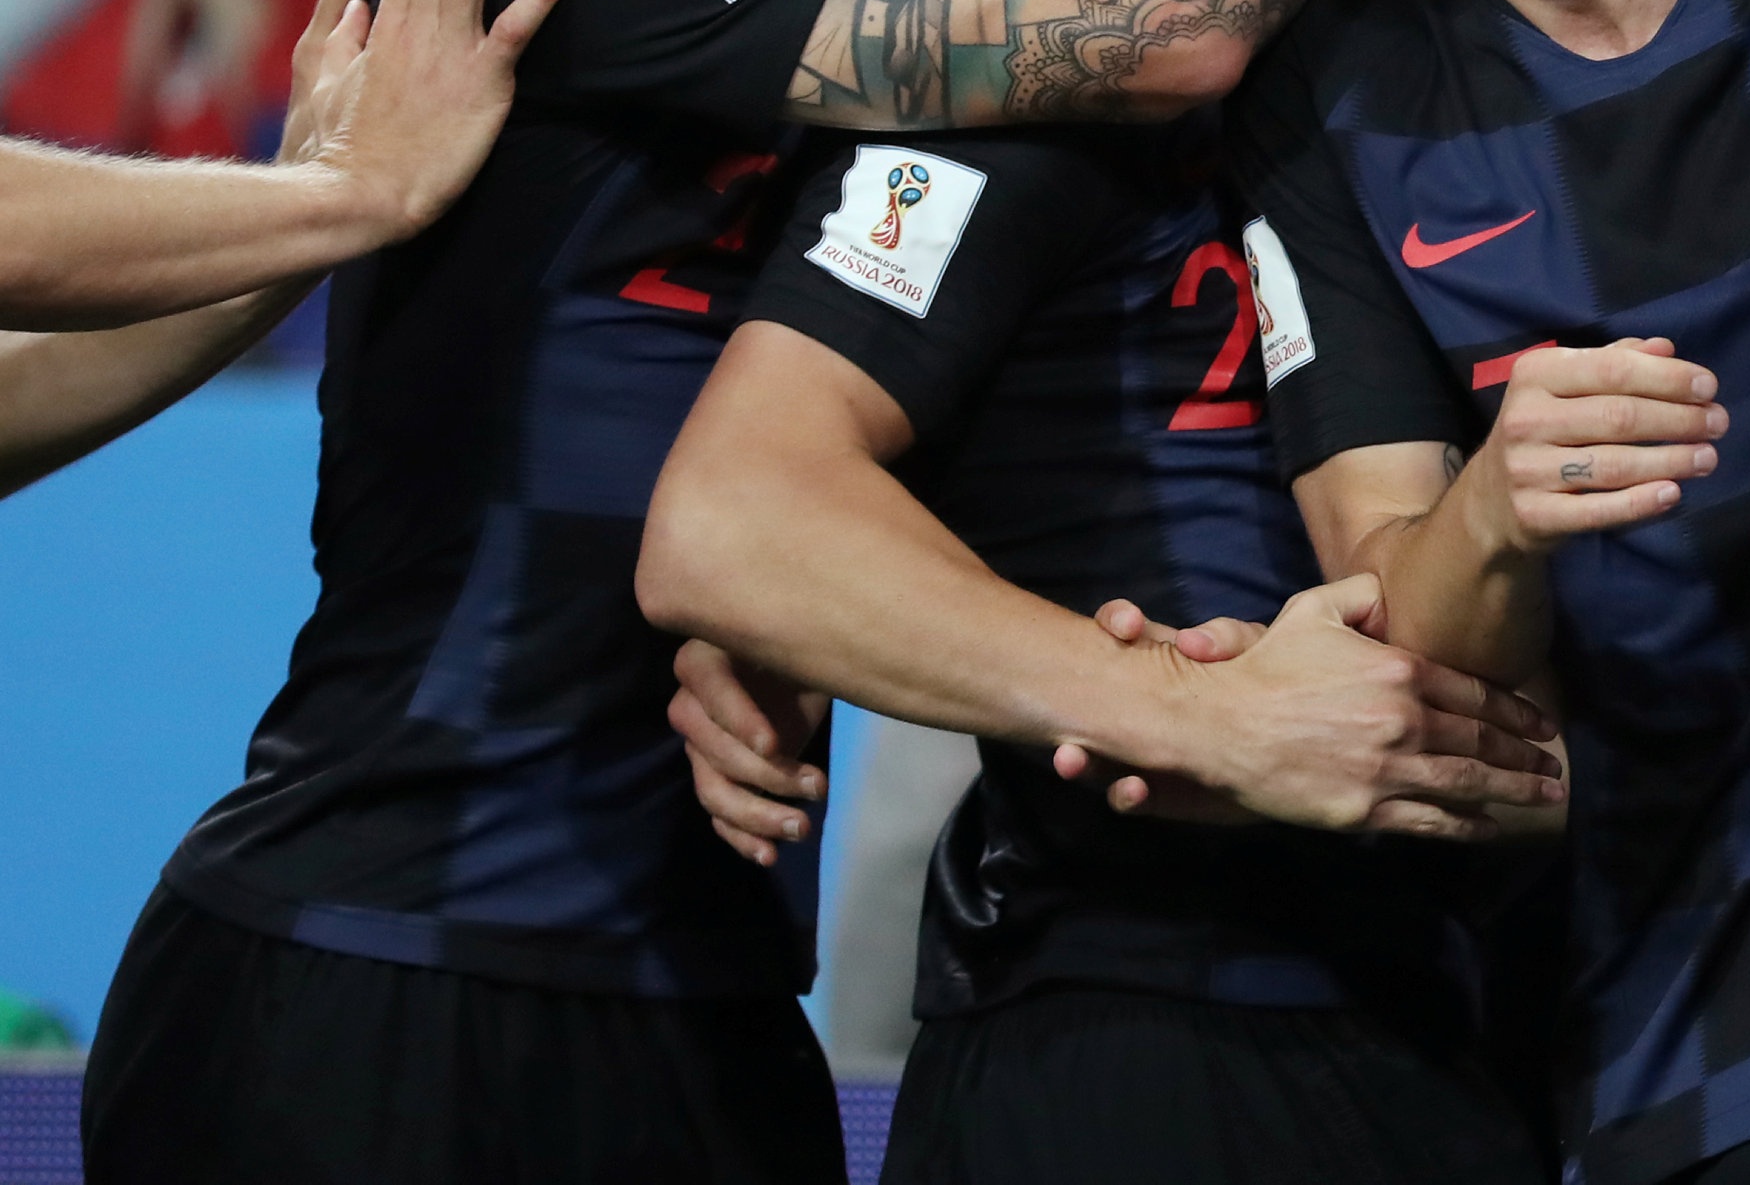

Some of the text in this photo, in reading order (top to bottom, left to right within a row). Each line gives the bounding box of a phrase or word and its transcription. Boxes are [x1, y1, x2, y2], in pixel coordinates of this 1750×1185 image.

[821, 245, 923, 302] RUSSIA 2018
[860, 249, 890, 268] WORLD
[889, 262, 906, 275] CUP
[1281, 336, 1308, 361] 2018
